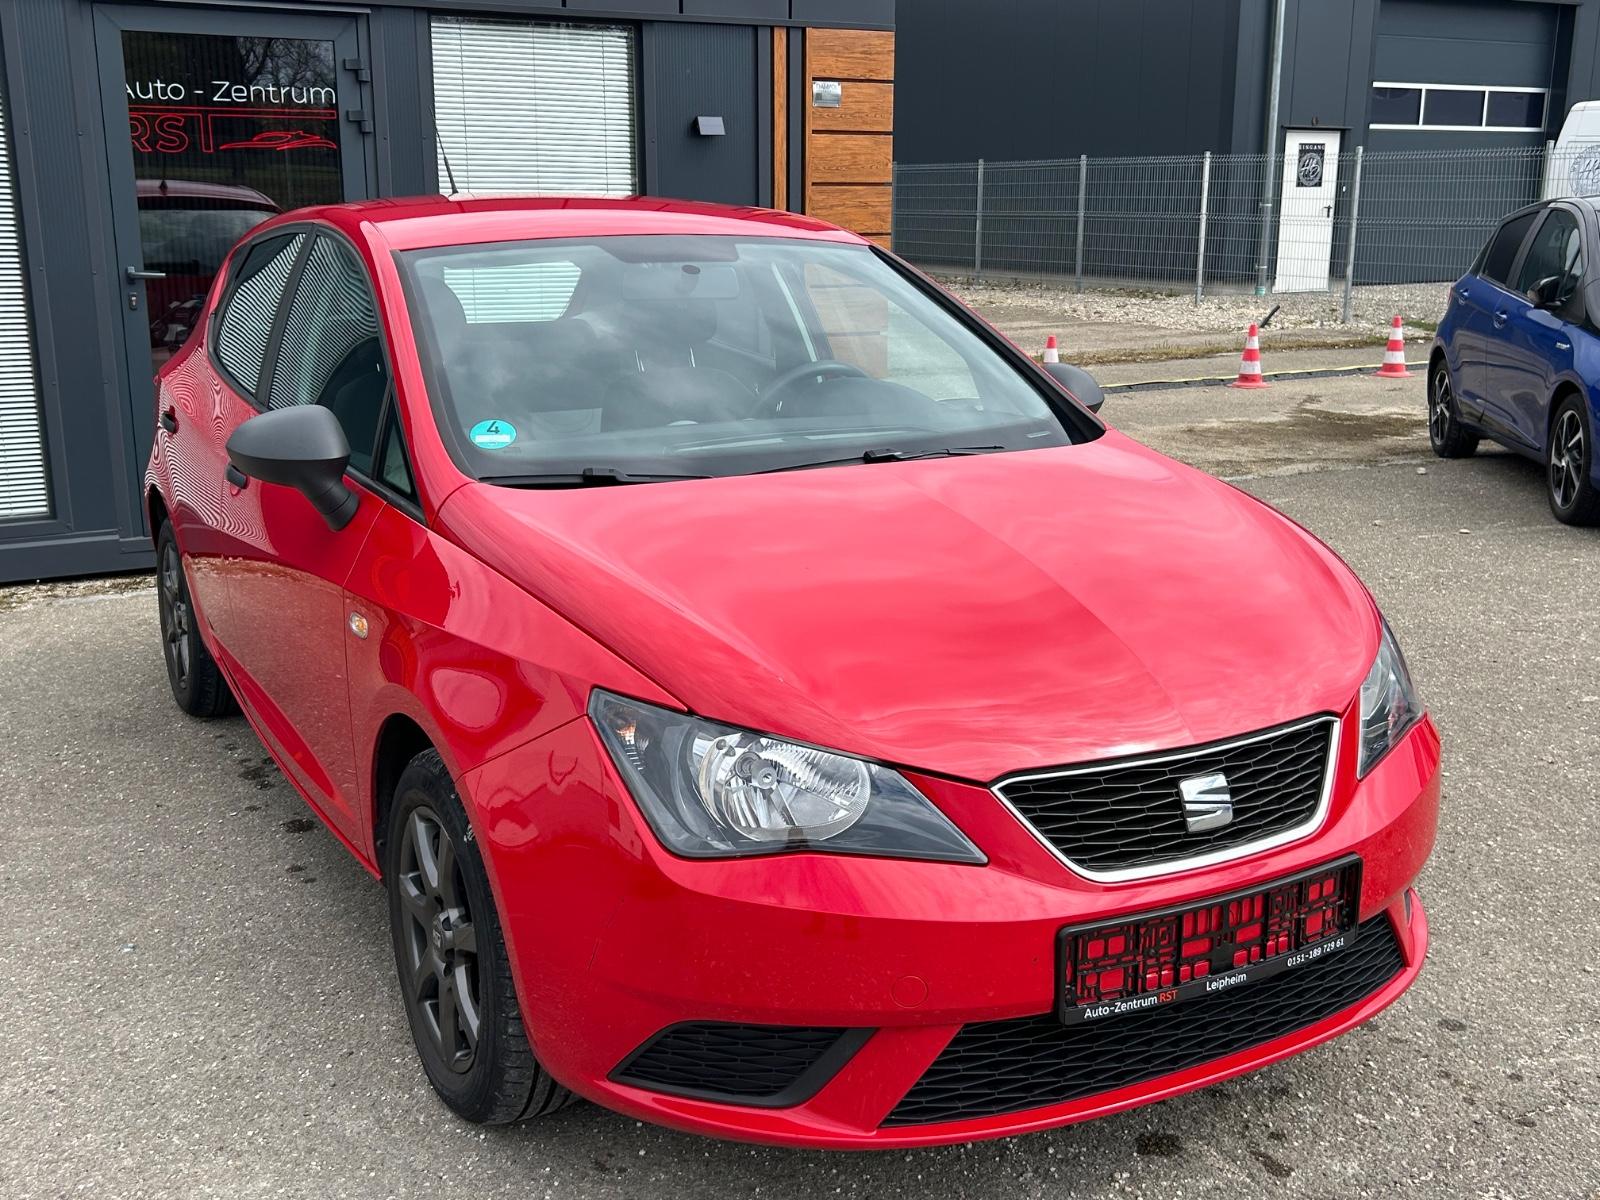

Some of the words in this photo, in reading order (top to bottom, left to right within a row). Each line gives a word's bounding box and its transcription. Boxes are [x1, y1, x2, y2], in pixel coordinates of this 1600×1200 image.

[211, 81, 336, 104] Zentrum
[486, 420, 500, 434] 4
[1206, 972, 1247, 992] Leipheim
[1084, 995, 1158, 1019] Auto-Zentrum
[1159, 989, 1179, 1003] RST
